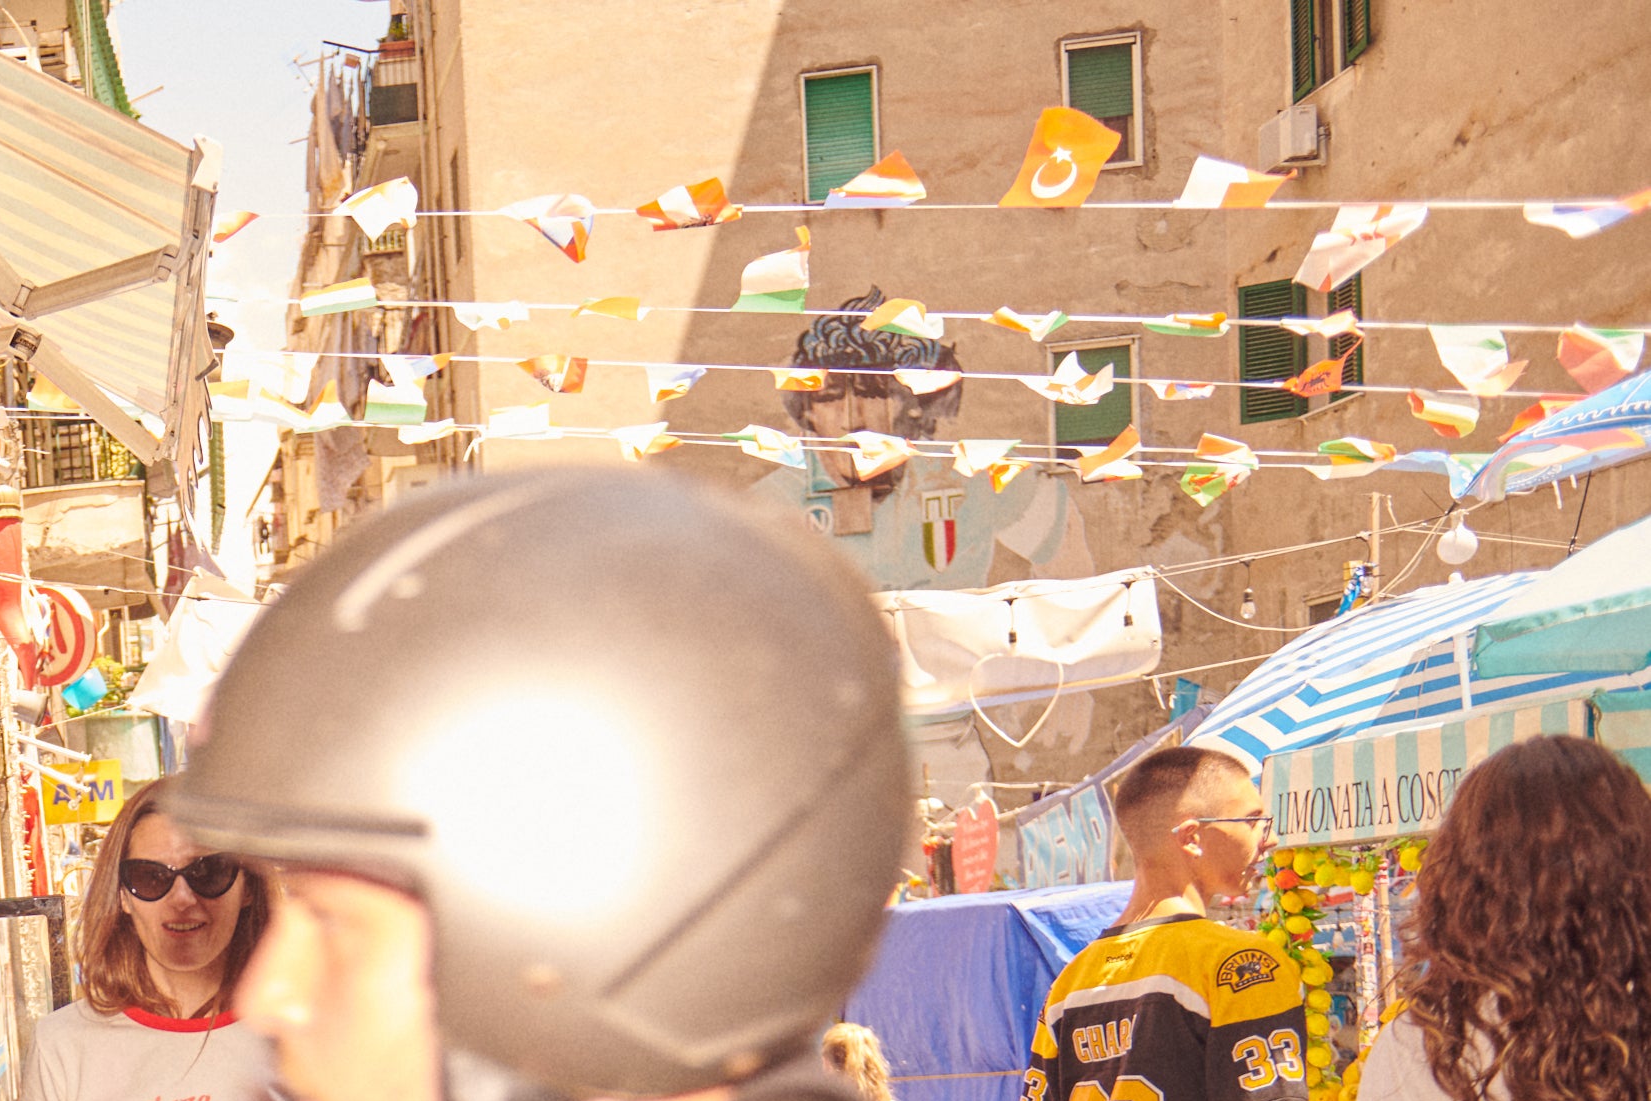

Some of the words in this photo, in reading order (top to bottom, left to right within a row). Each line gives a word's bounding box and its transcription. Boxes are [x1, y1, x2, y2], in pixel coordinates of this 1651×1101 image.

[53, 779, 114, 806] AM
[1278, 781, 1374, 835] LIMONATA
[1378, 778, 1392, 824] A
[1220, 951, 1274, 982] BRUINS
[1232, 1028, 1305, 1092] 33
